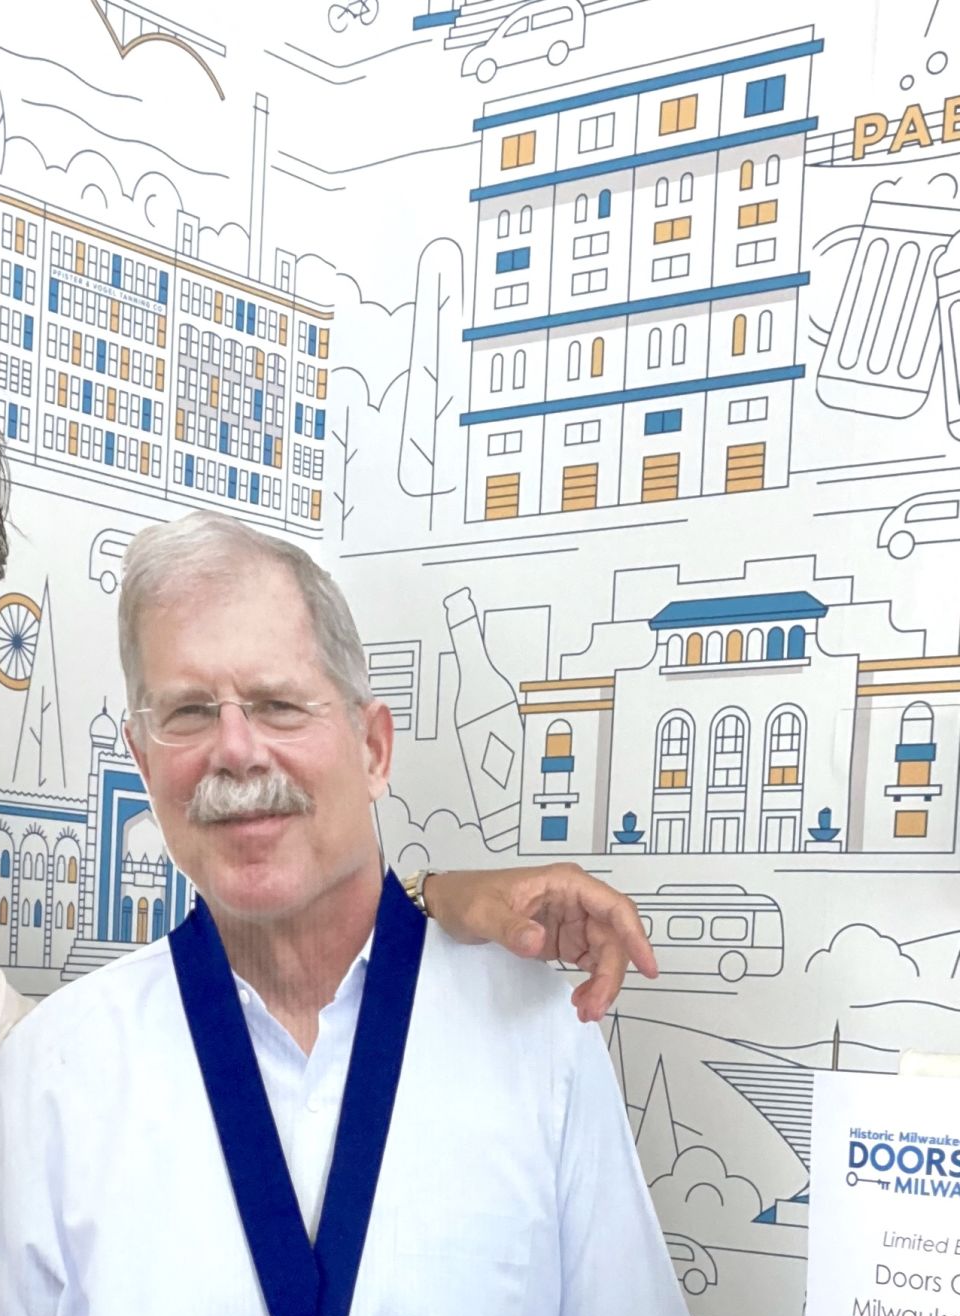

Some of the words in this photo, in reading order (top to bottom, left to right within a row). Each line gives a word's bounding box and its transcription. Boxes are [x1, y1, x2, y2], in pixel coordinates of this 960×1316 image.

[52, 269, 83, 284] PFISTER
[93, 282, 116, 296] VOGEL
[119, 292, 150, 308] TANNING
[849, 1128, 894, 1141] Historic
[883, 1231, 949, 1254] Limited
[876, 1264, 942, 1292] Doors
